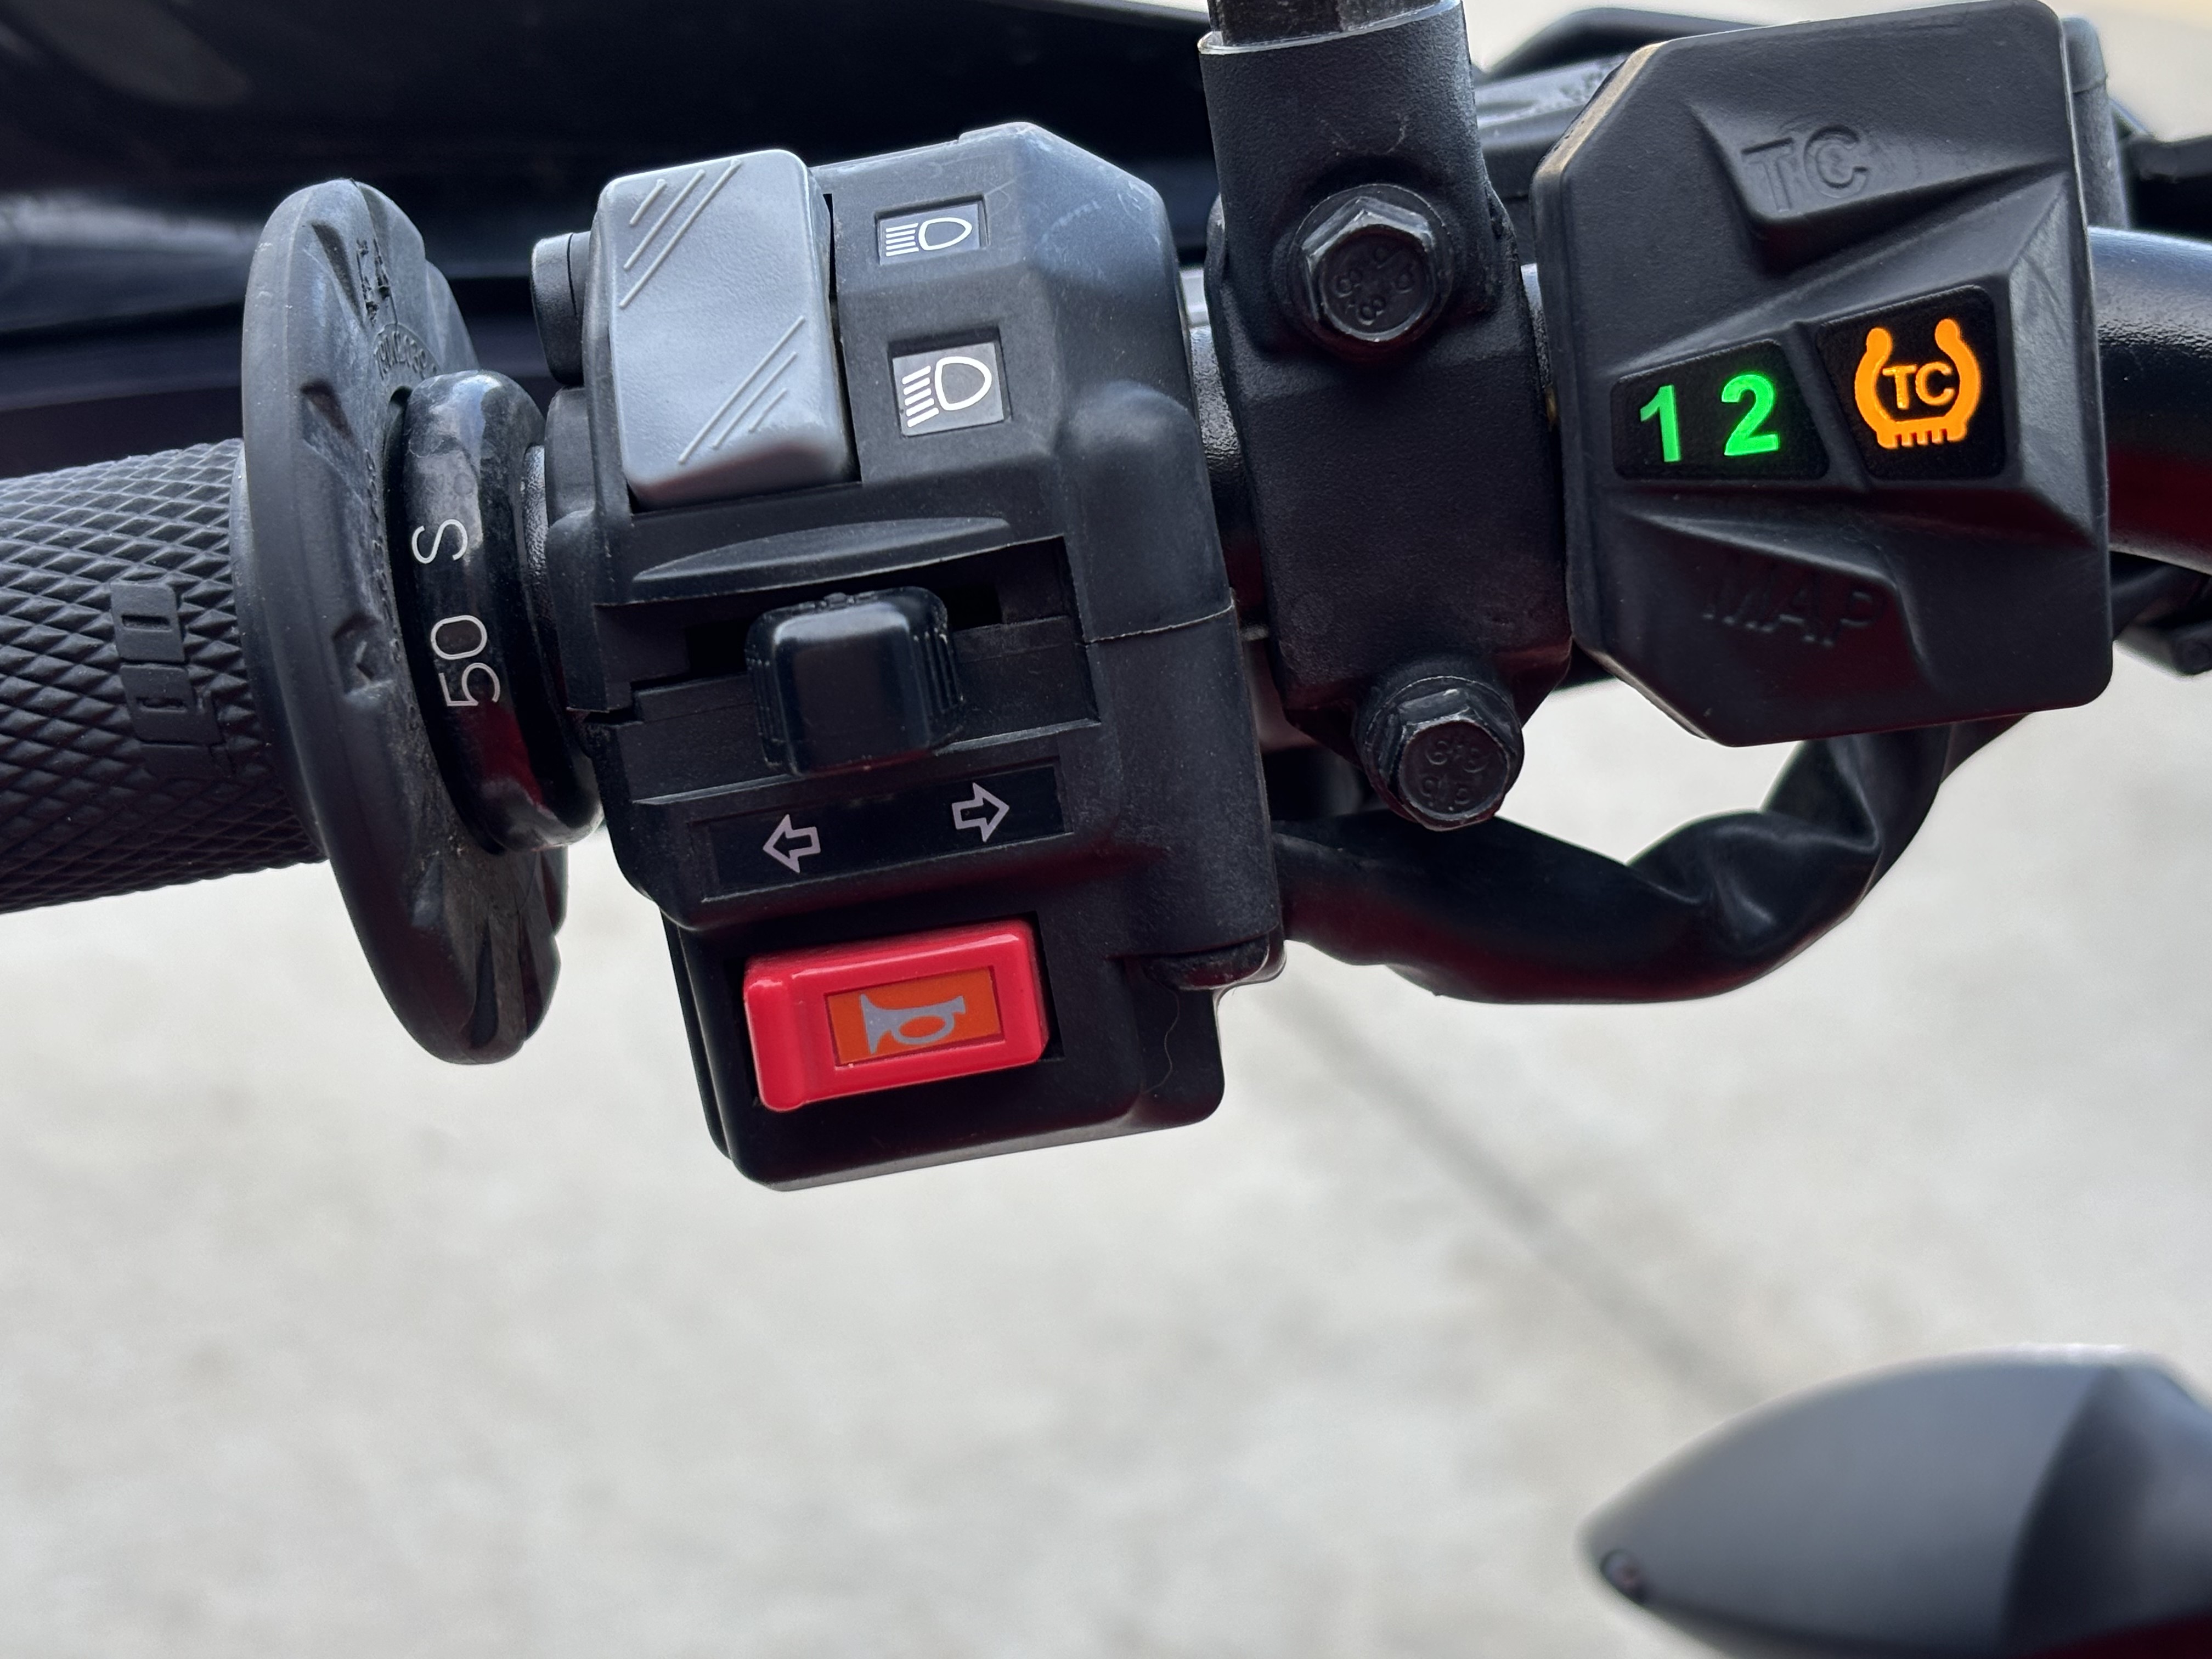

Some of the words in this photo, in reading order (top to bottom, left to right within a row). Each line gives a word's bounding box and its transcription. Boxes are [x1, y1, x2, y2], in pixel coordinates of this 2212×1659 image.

[1741, 124, 1868, 212] TC
[1640, 385, 1681, 462] 1
[1721, 374, 1779, 456] 2
[1883, 362, 1956, 410] TC
[412, 519, 468, 563] S
[1700, 557, 1885, 643] MAP
[431, 615, 500, 707] 50
